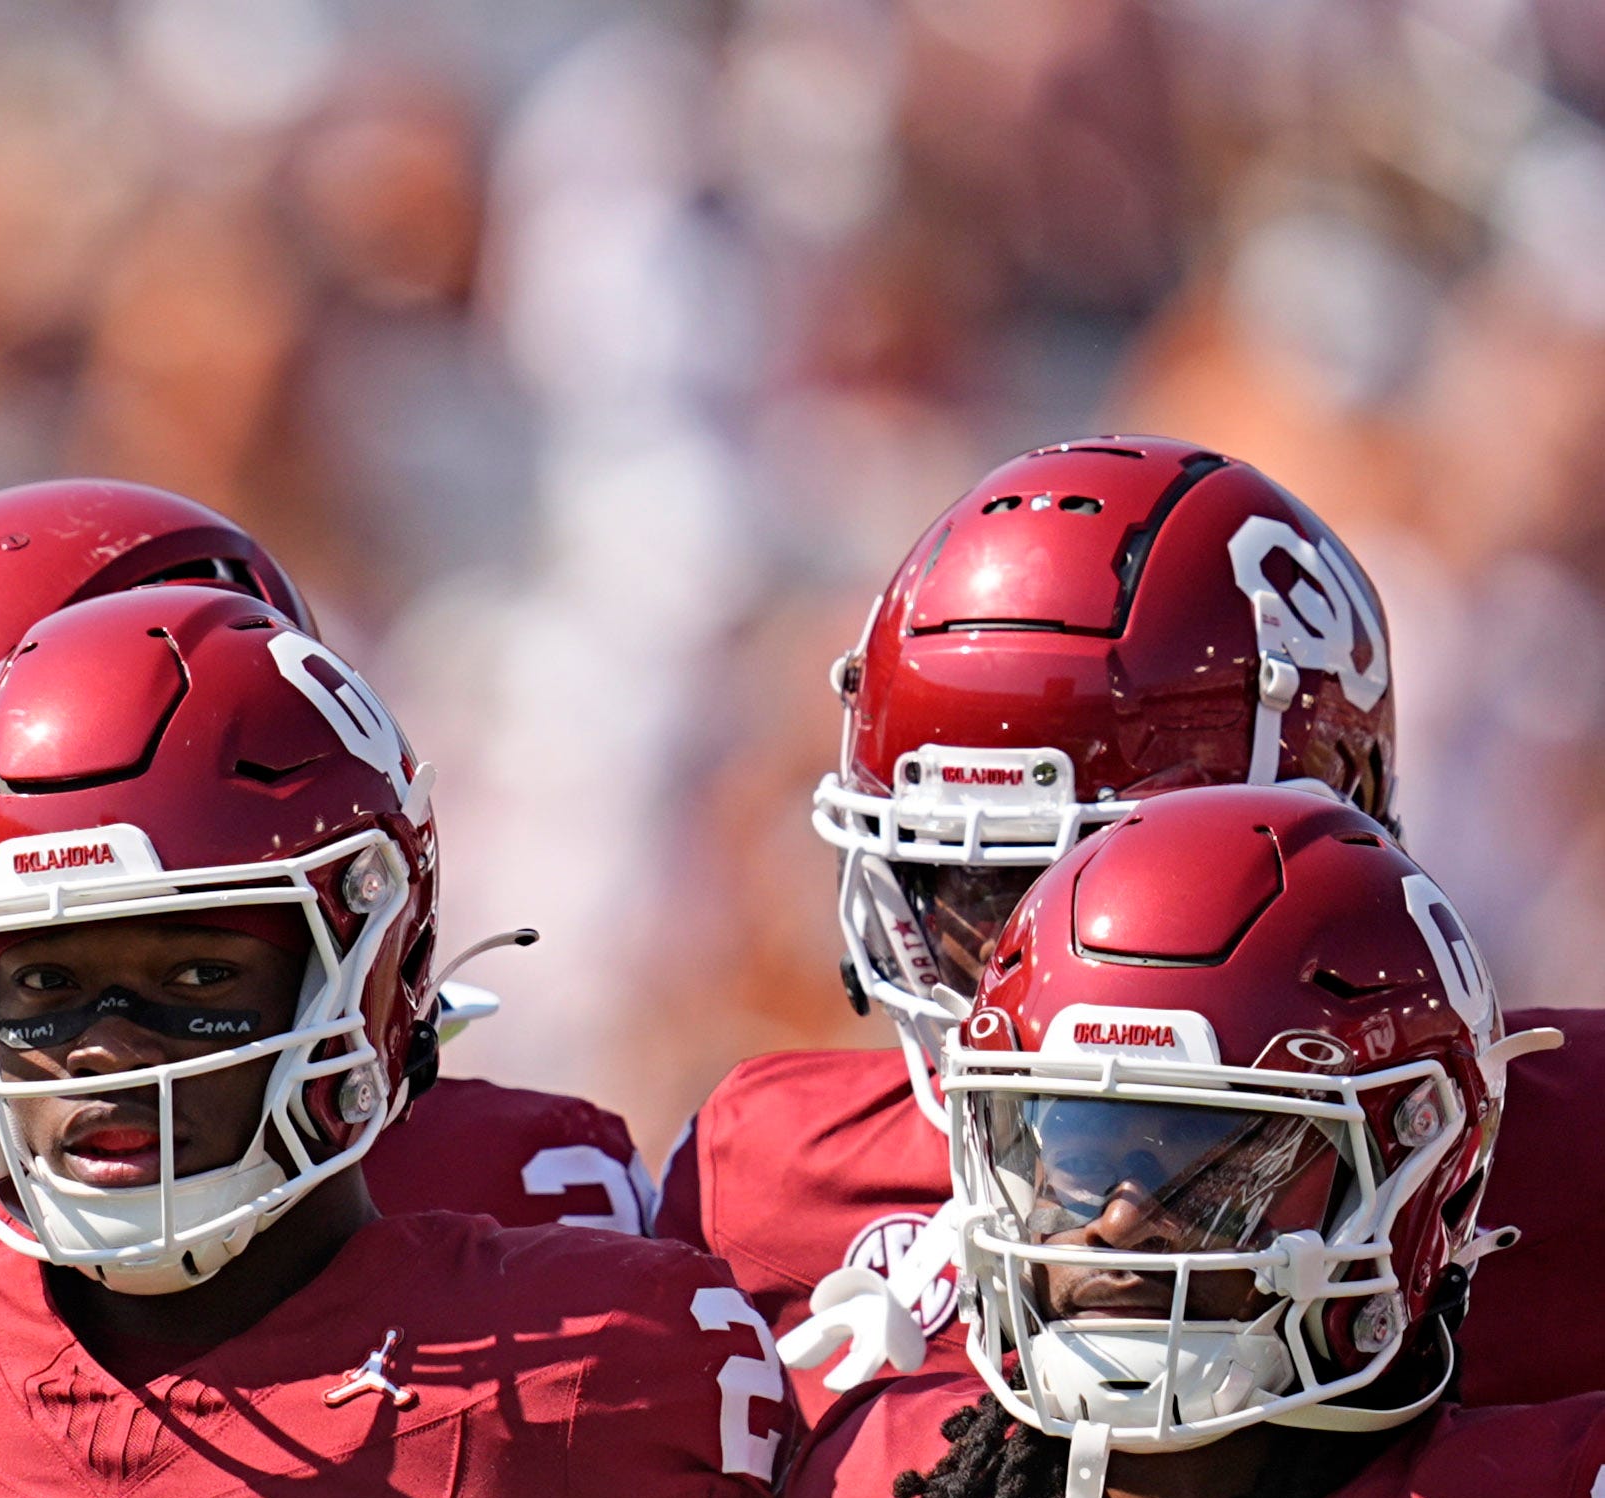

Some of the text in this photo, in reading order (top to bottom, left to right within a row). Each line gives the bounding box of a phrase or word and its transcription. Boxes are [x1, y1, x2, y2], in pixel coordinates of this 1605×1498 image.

[13, 843, 114, 875] OKLAHOMA
[1073, 1022, 1175, 1047] OKLAHOMA
[690, 1287, 784, 1483] 2
